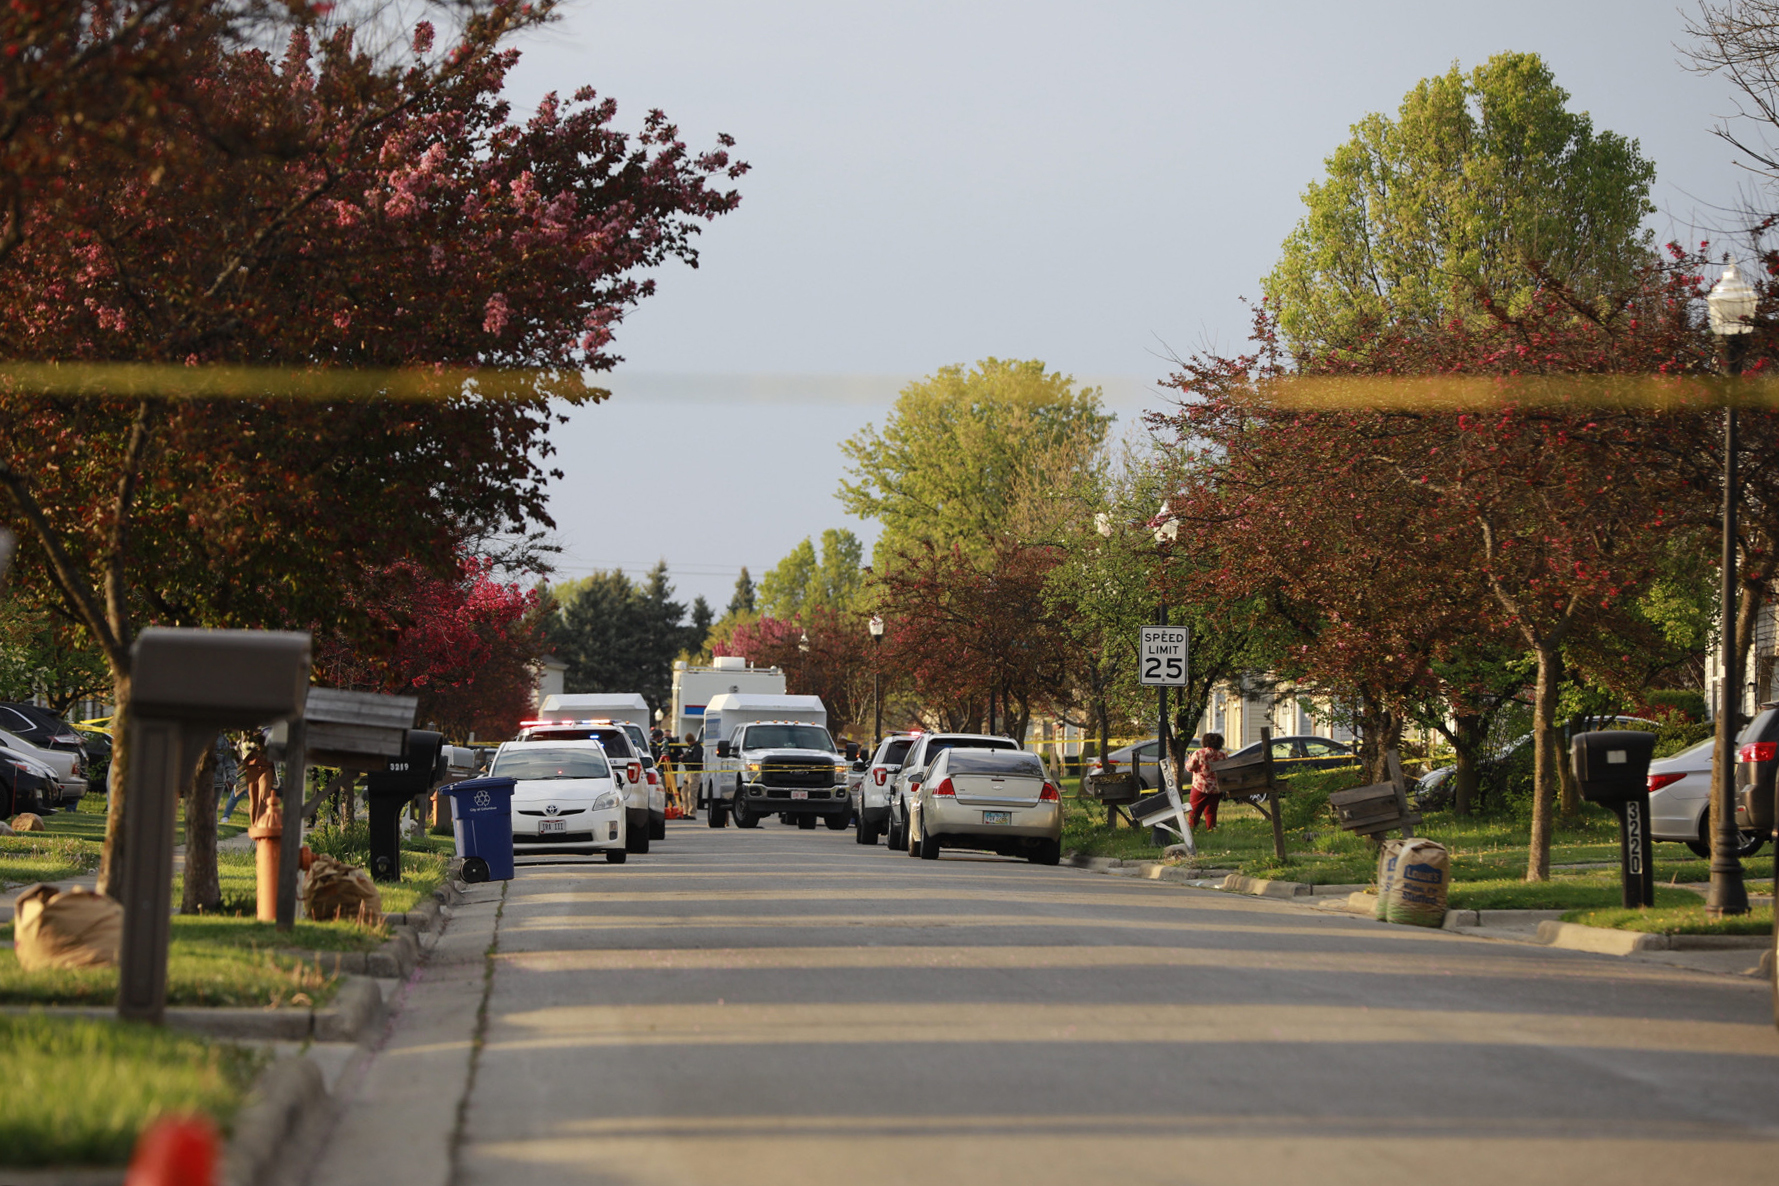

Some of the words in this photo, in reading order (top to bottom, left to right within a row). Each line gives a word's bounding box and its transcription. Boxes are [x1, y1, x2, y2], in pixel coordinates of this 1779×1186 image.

[1145, 633, 1184, 642] SPEED
[1149, 645, 1179, 654] LIMIT
[1145, 657, 1182, 678] 25
[1628, 802, 1640, 873] 3220
